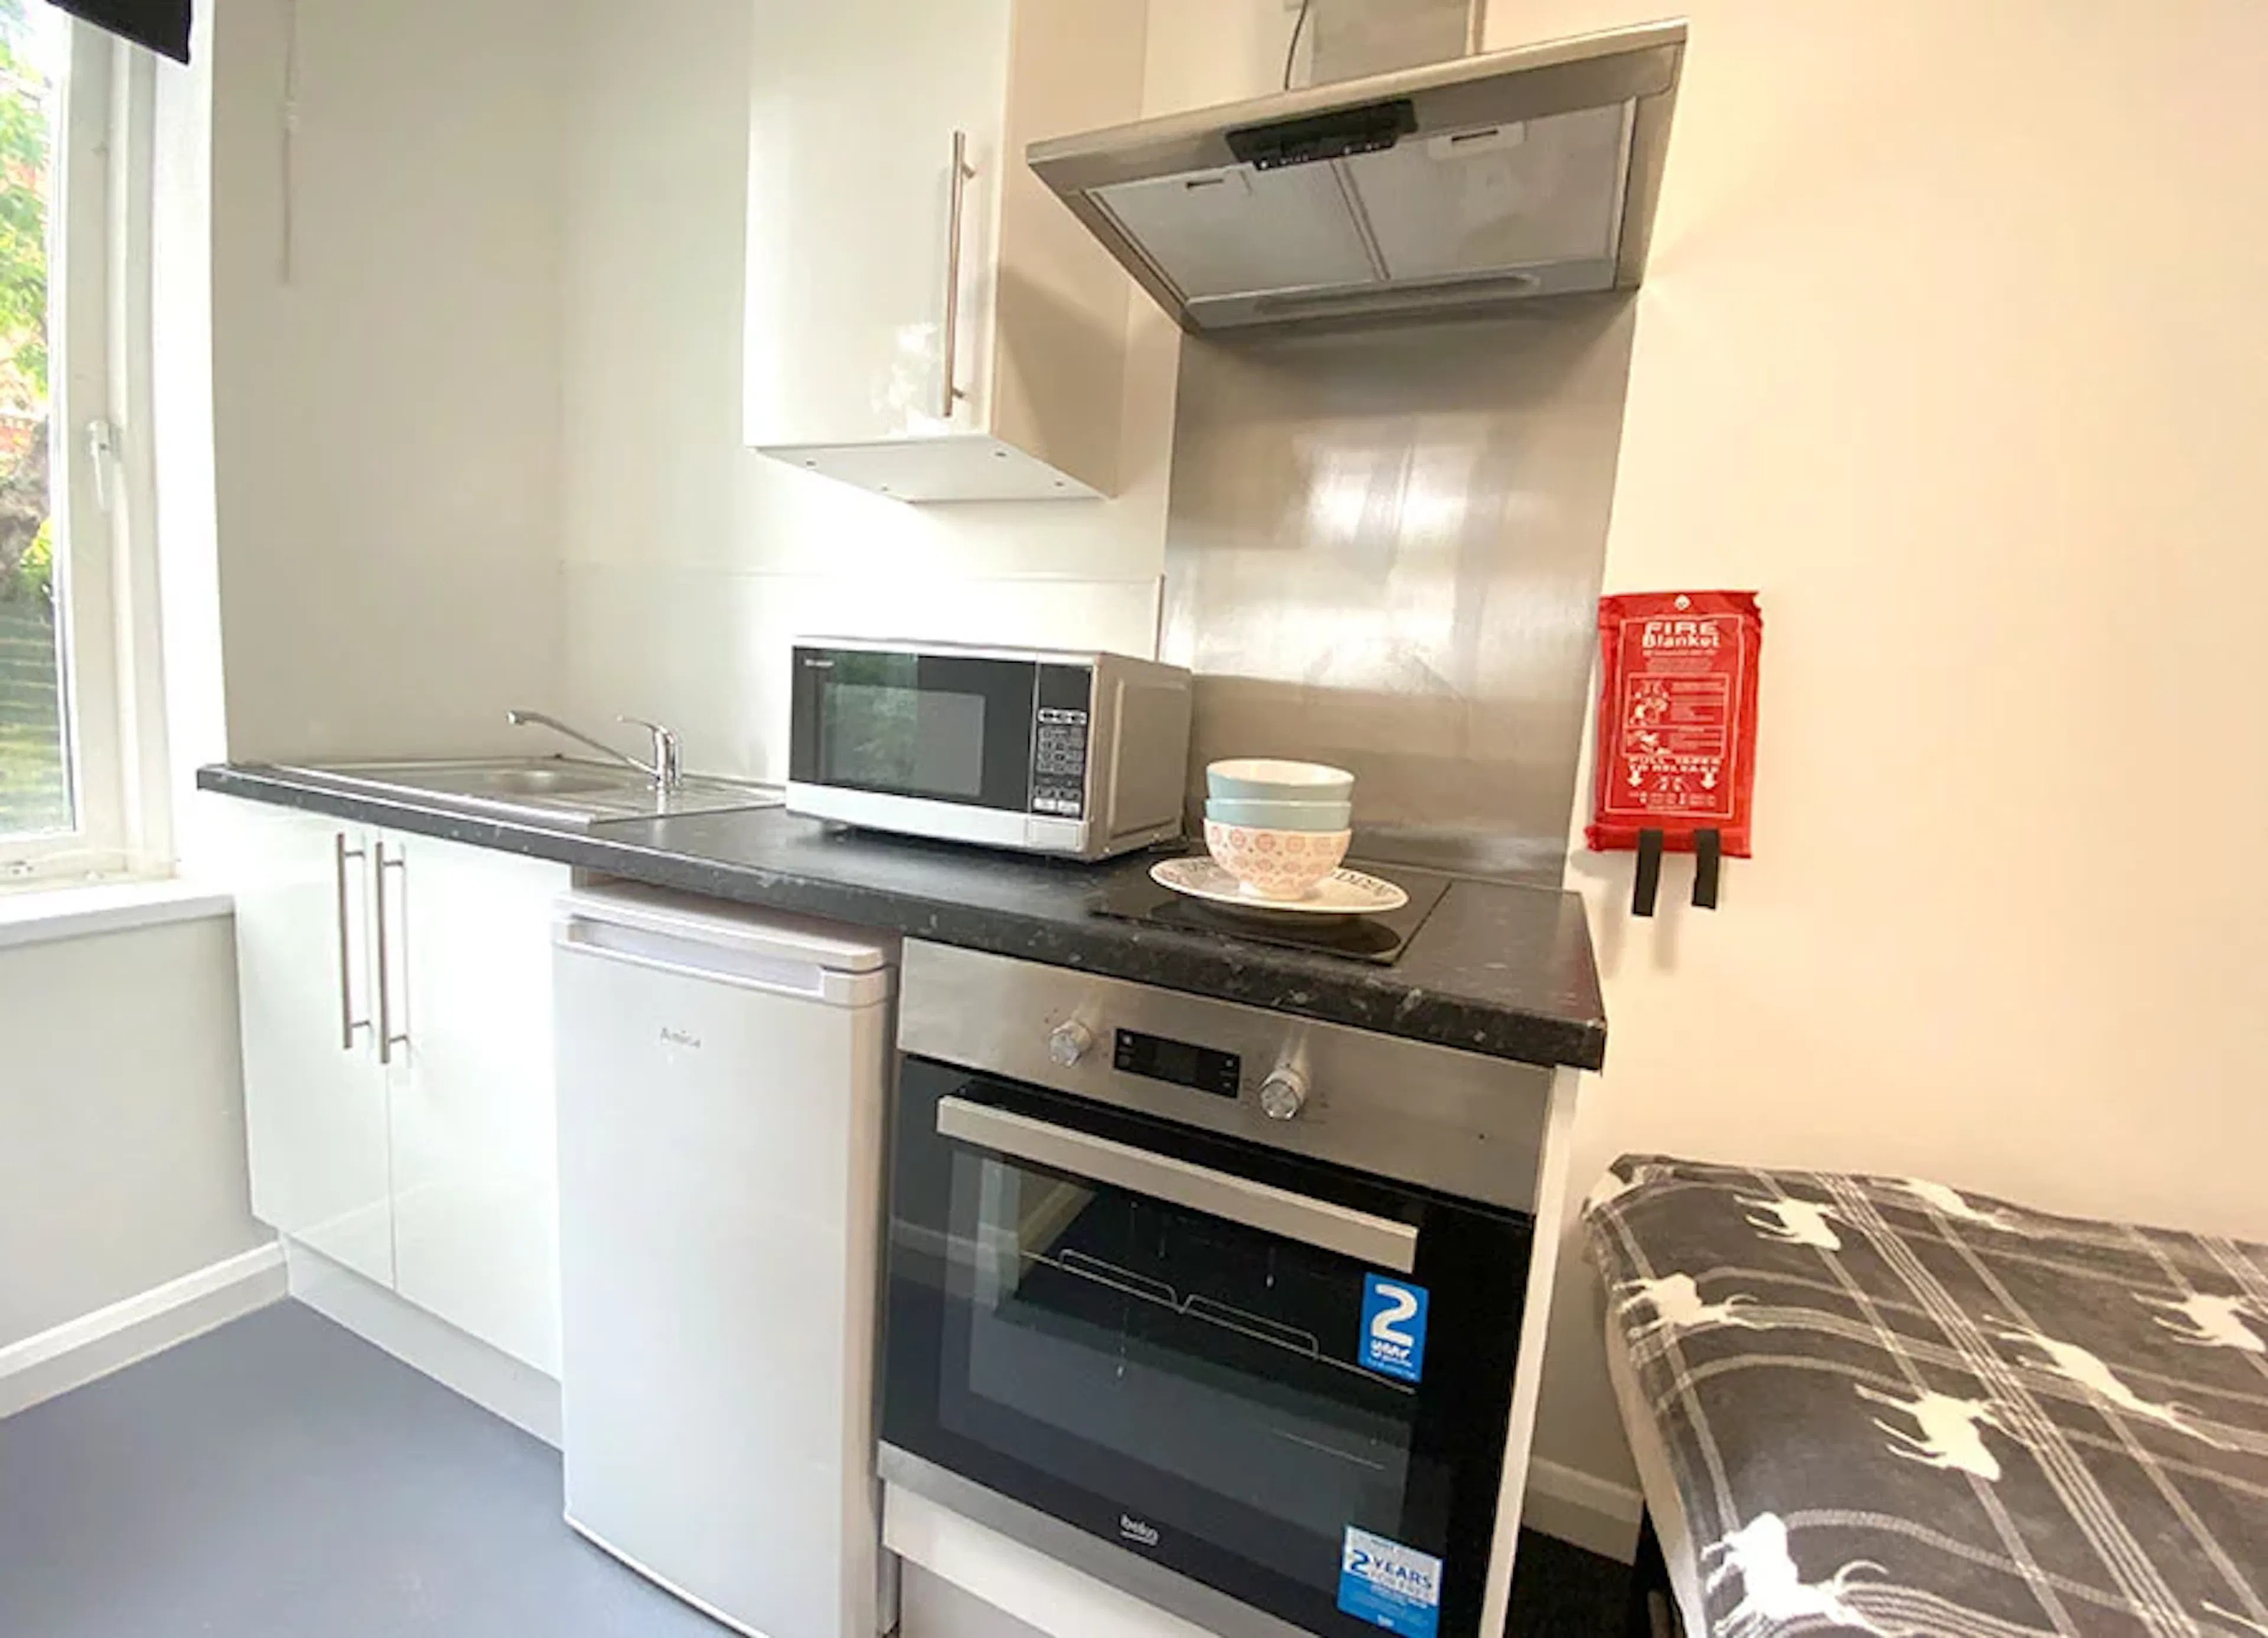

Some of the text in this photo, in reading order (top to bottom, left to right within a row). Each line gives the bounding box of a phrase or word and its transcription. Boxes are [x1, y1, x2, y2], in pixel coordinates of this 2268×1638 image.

[1645, 620, 1719, 635] FIRE
[1642, 634, 1720, 649] Blanket
[1370, 1284, 1418, 1347] 2
[1351, 1549, 1370, 1575] 2
[1374, 1556, 1432, 1589] YEARS
